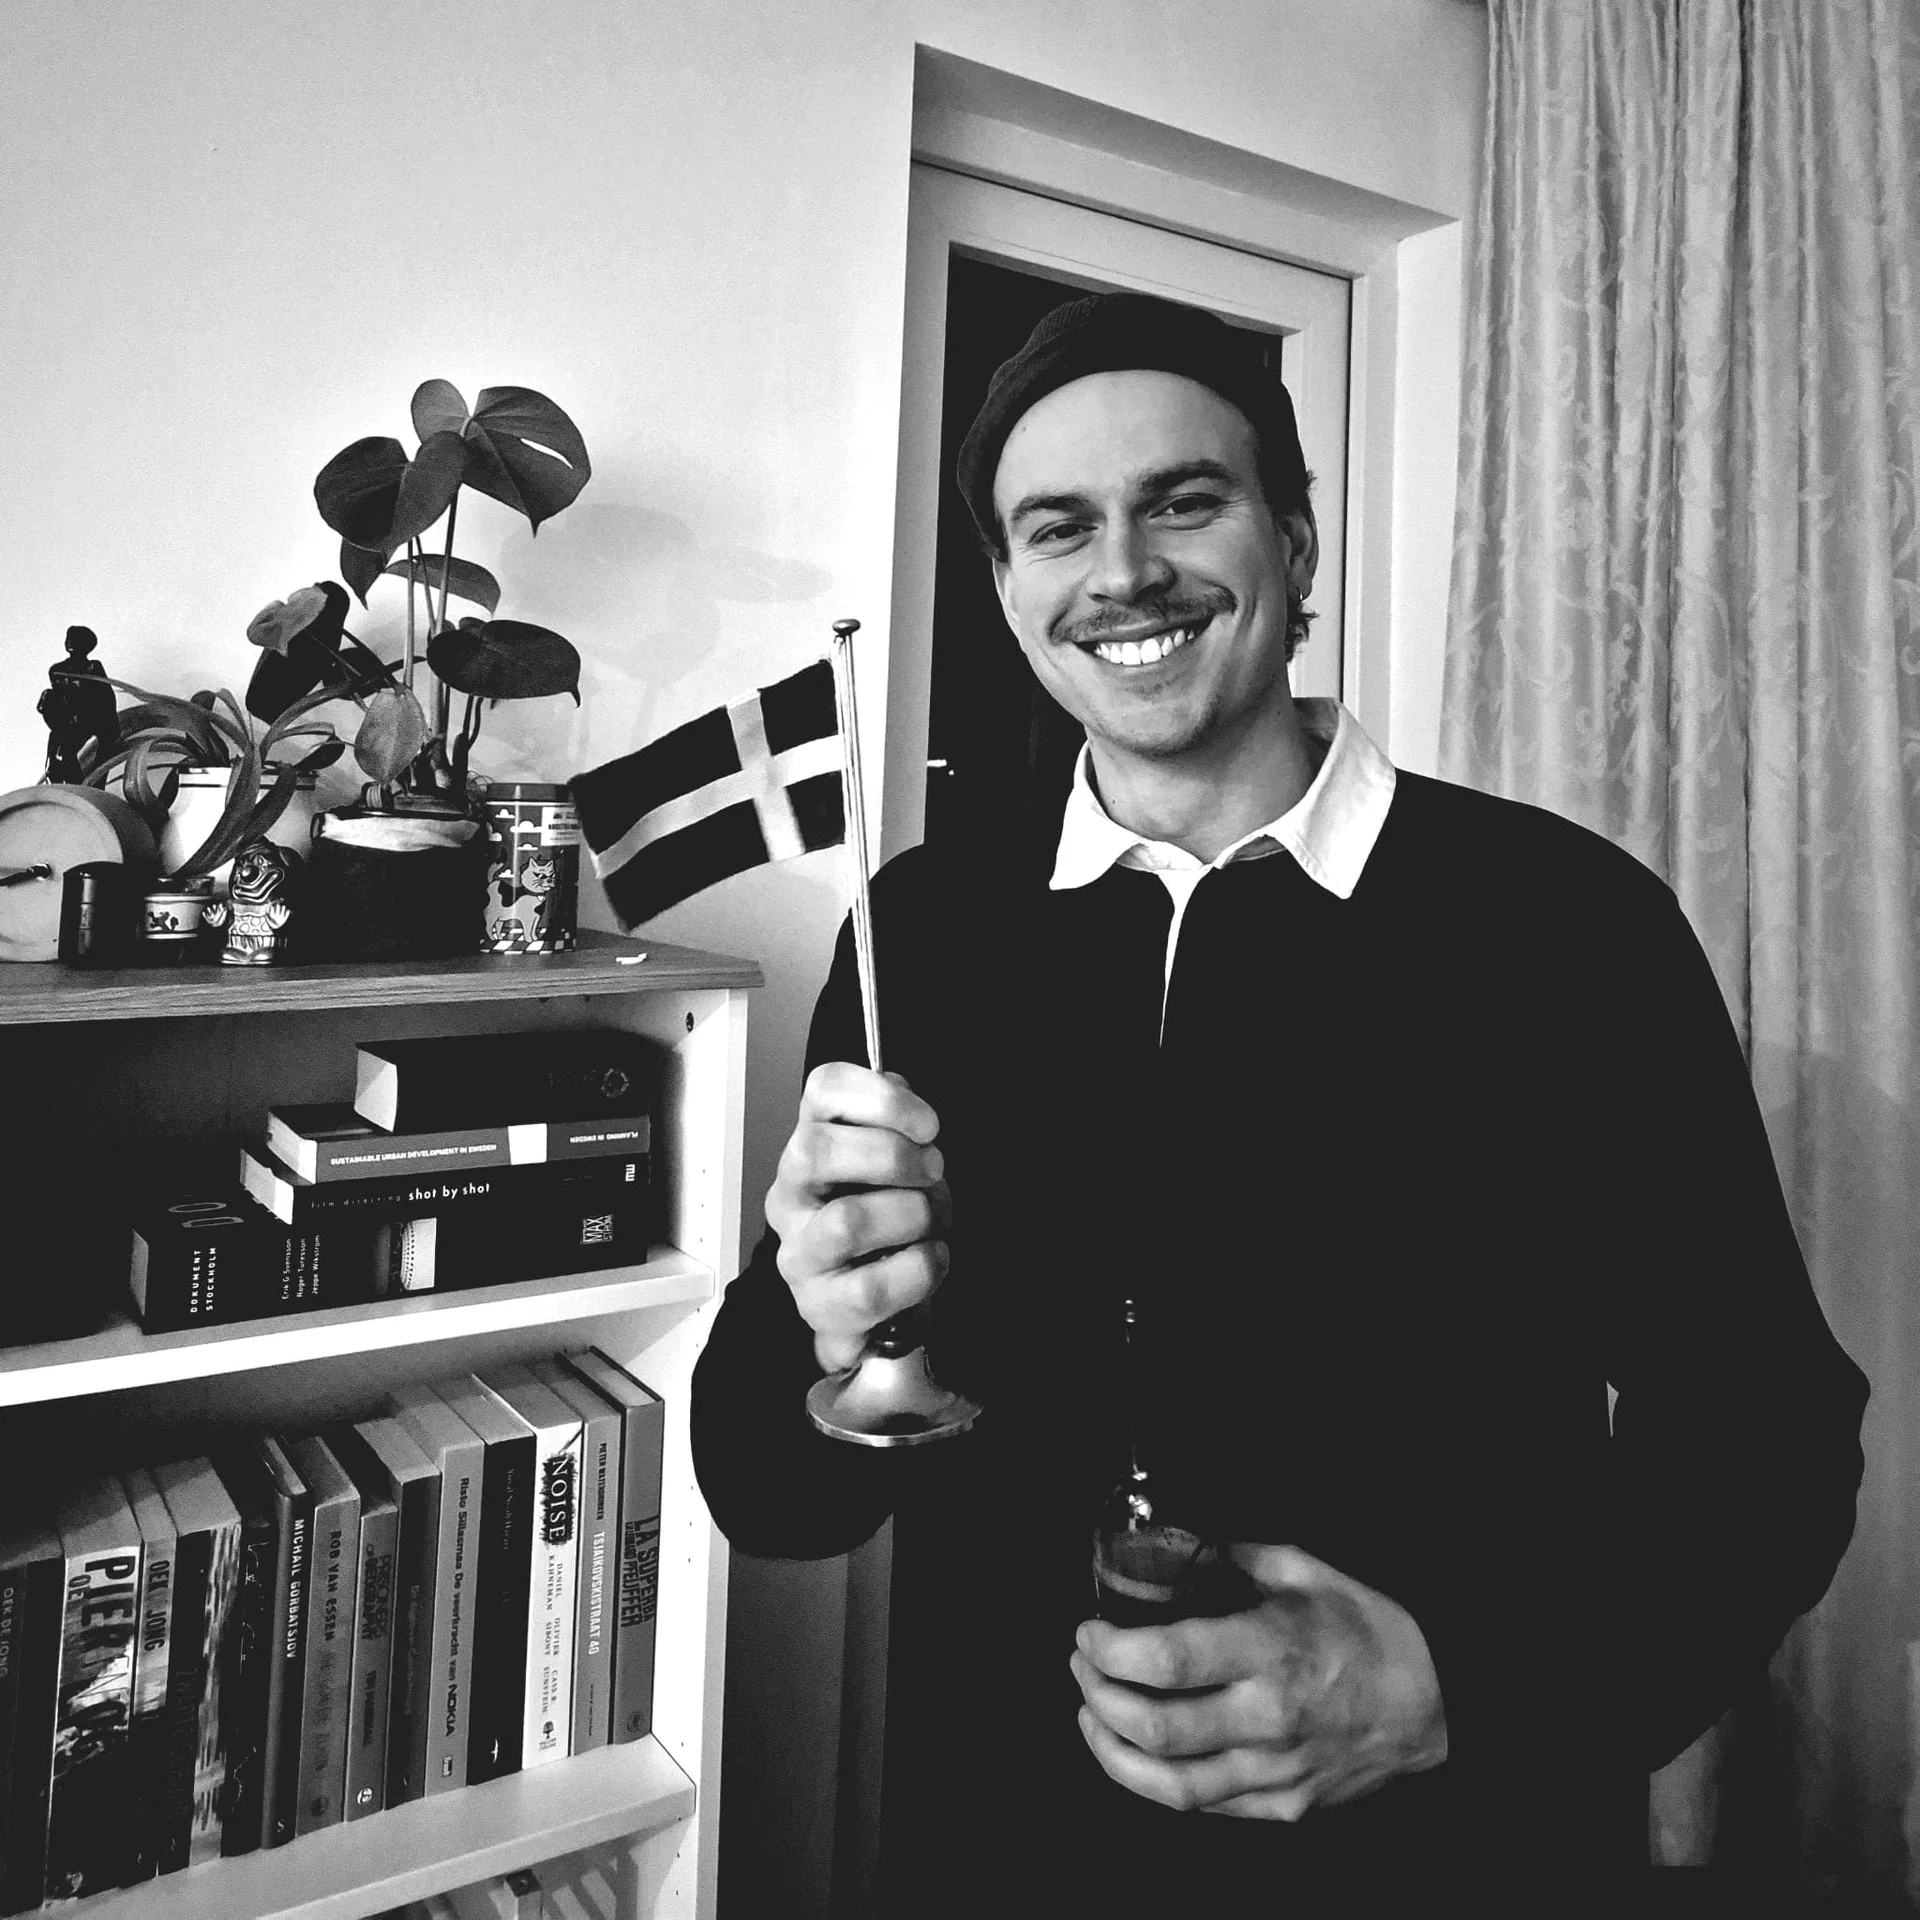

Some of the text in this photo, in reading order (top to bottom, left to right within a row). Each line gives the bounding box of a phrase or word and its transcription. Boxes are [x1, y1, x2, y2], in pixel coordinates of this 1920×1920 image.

[330, 1143, 498, 1165] SUSTAINABLE URBAN DEVELOPMENT IN SWEDEN
[408, 1187, 437, 1201] shot
[442, 1185, 459, 1200] by
[461, 1182, 491, 1196] shot
[584, 1216, 604, 1243] MAX
[190, 1250, 202, 1313] DOKUMENT
[205, 1247, 217, 1312] STOCKHOLM
[281, 1284, 290, 1300] Erik
[458, 1478, 470, 1508] Risto
[549, 1457, 569, 1540] NOISE
[329, 1530, 342, 1559] ROB
[634, 1514, 660, 1547] LA
[148, 1560, 170, 1592] OEK
[286, 1519, 305, 1659] MICHAIL GORBATSJOV
[327, 1563, 340, 1592] VAN
[453, 1573, 464, 1589] De
[546, 1554, 555, 1611] KAHNEMAN
[555, 1563, 563, 1598] DANIEL
[588, 1531, 605, 1655] TSJAIKOVSKISTRAAT 40
[2, 1587, 14, 1615] OEK
[80, 1555, 136, 1653] PIER
[144, 1610, 167, 1651] JONG
[324, 1598, 338, 1641] ESSEN
[553, 1617, 561, 1656] OLIVIER
[448, 1659, 457, 1681] van
[542, 1666, 551, 1713] SUNSTEIN
[445, 1684, 458, 1737] NOKIA
